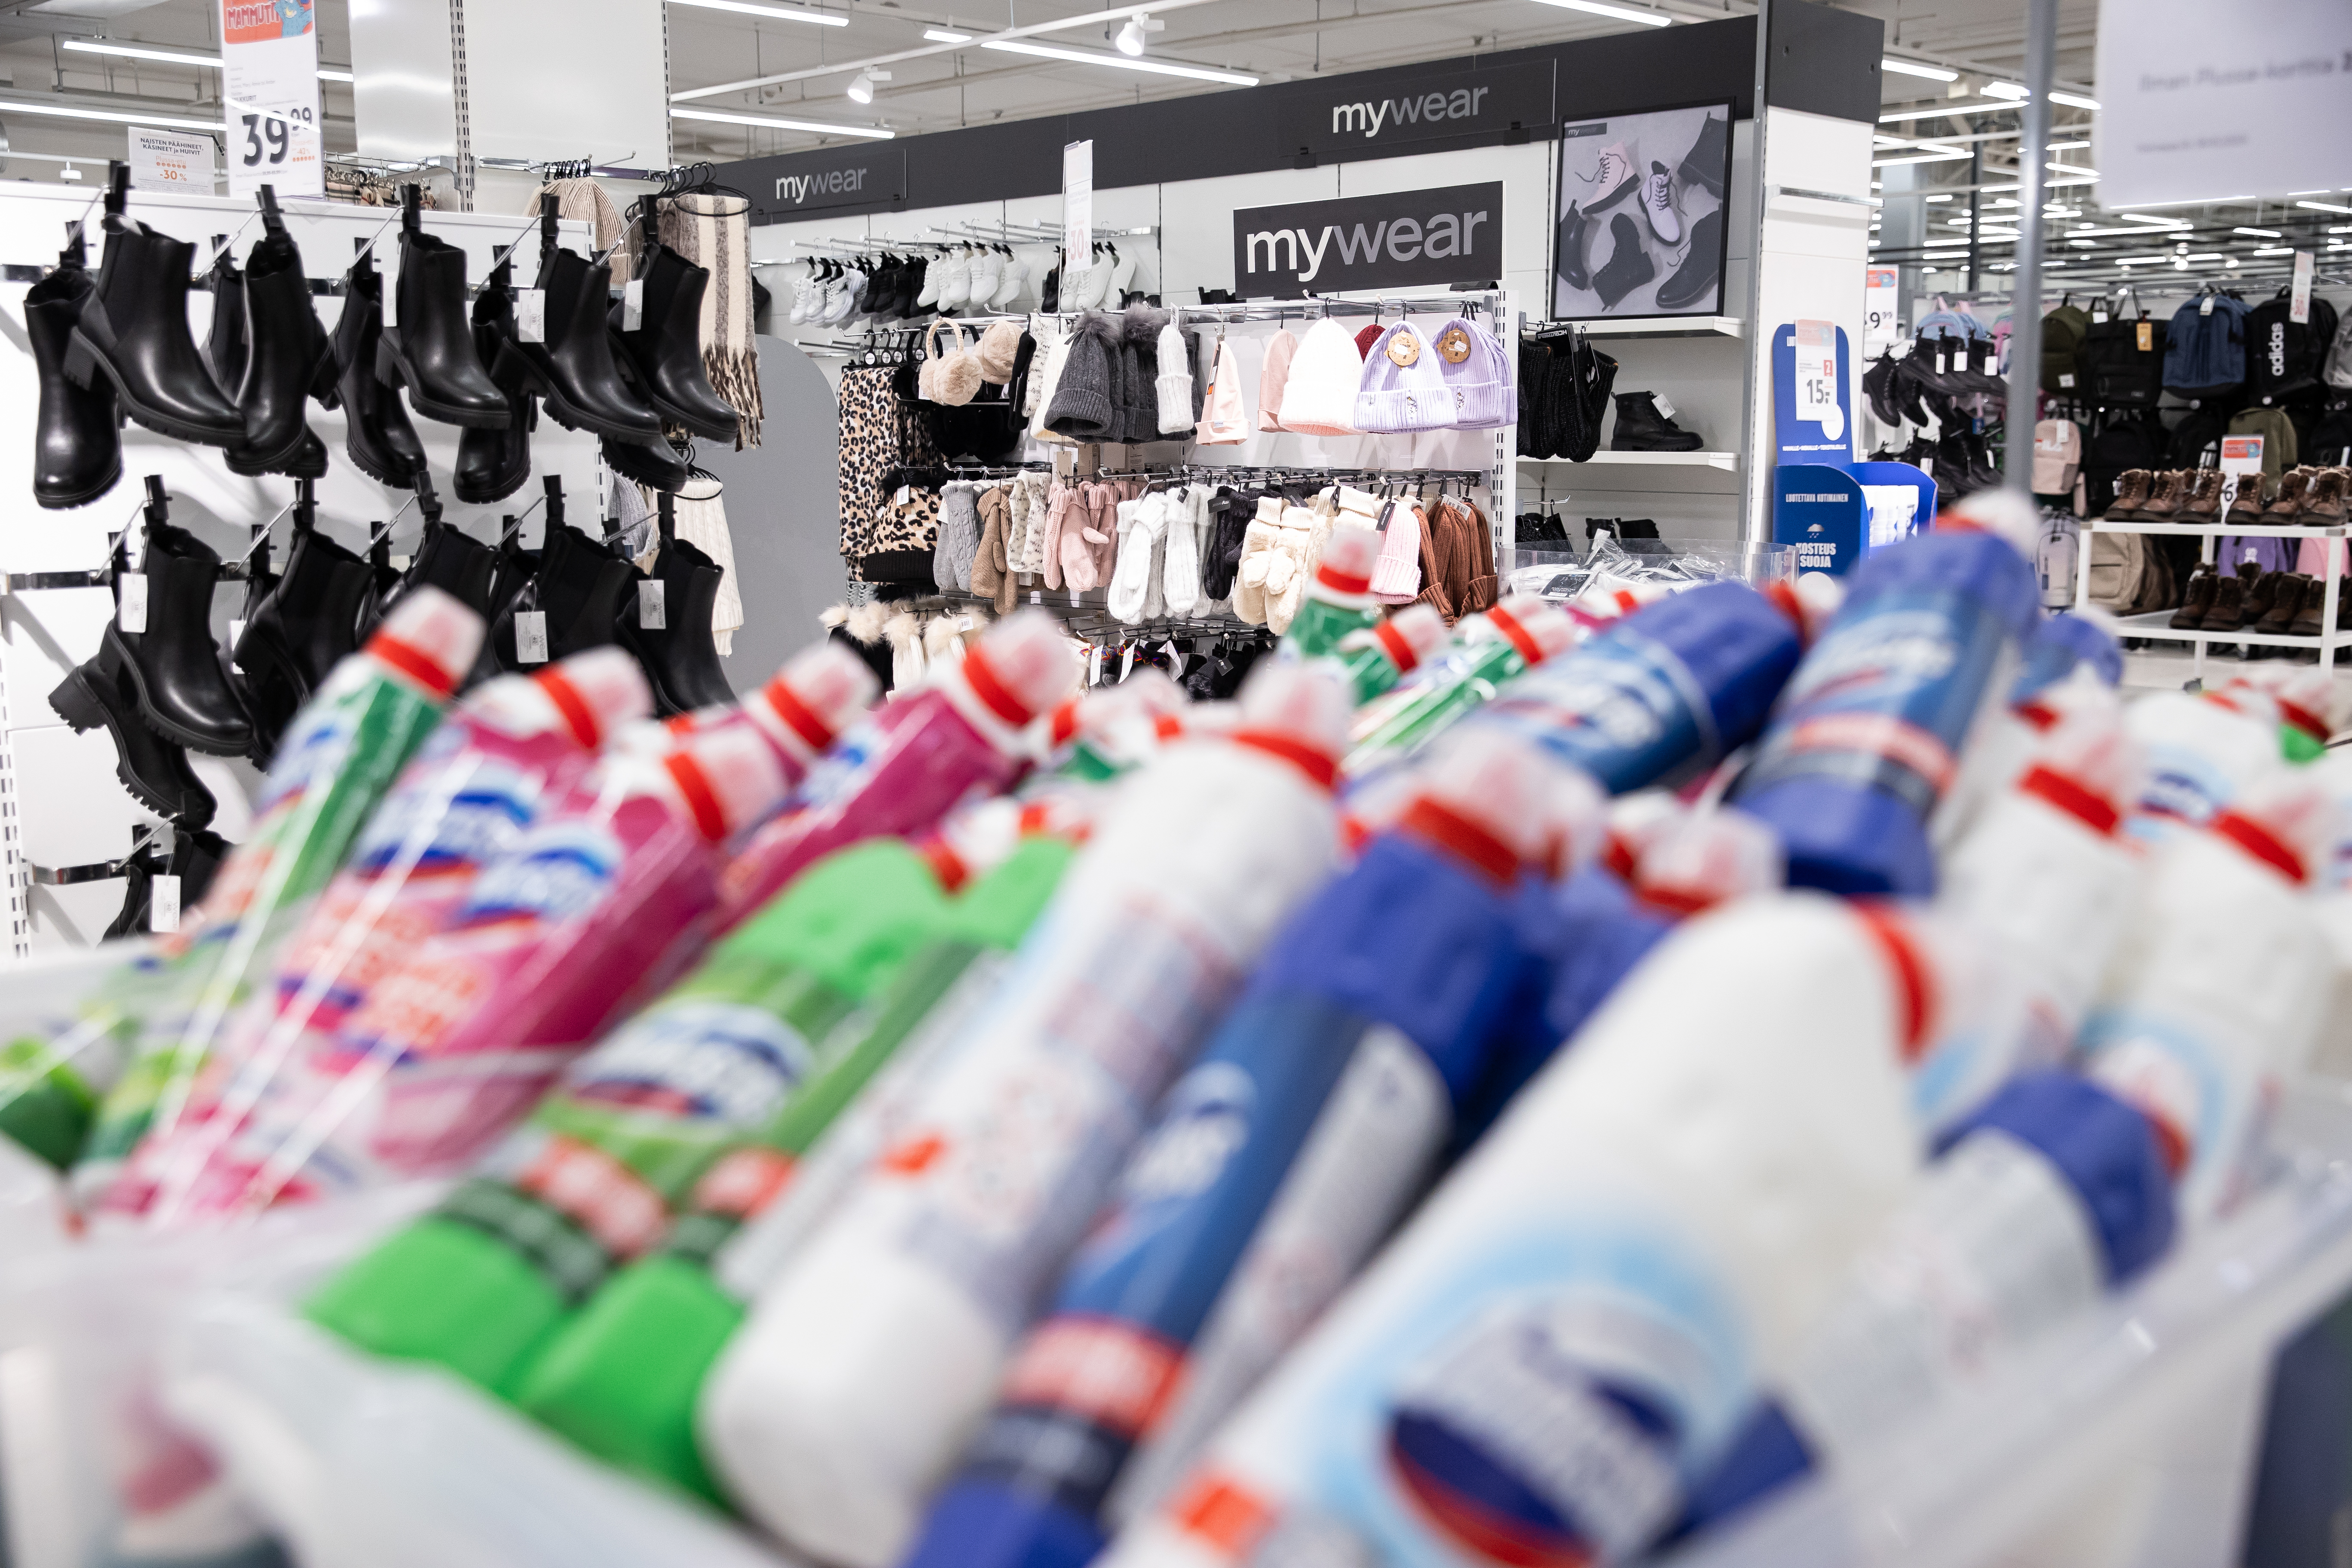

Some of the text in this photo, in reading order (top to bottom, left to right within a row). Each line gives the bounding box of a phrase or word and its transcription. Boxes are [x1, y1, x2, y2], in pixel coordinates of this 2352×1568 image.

[1333, 86, 1488, 138] mywear
[143, 143, 172, 152] KÄSINEET
[168, 140, 204, 151] PÄÄHINEET,
[242, 110, 289, 167] 39
[156, 155, 186, 164] Plussa-etu
[160, 169, 187, 181] -30 %
[776, 168, 867, 204] mywear
[1068, 228, 1084, 261] -30
[1247, 211, 1487, 282] mywear
[2268, 322, 2285, 376] adidas
[1381, 507, 1391, 525] mywear
[1796, 543, 1836, 555] KOSTEUS
[1800, 555, 1831, 567] SUOJA
